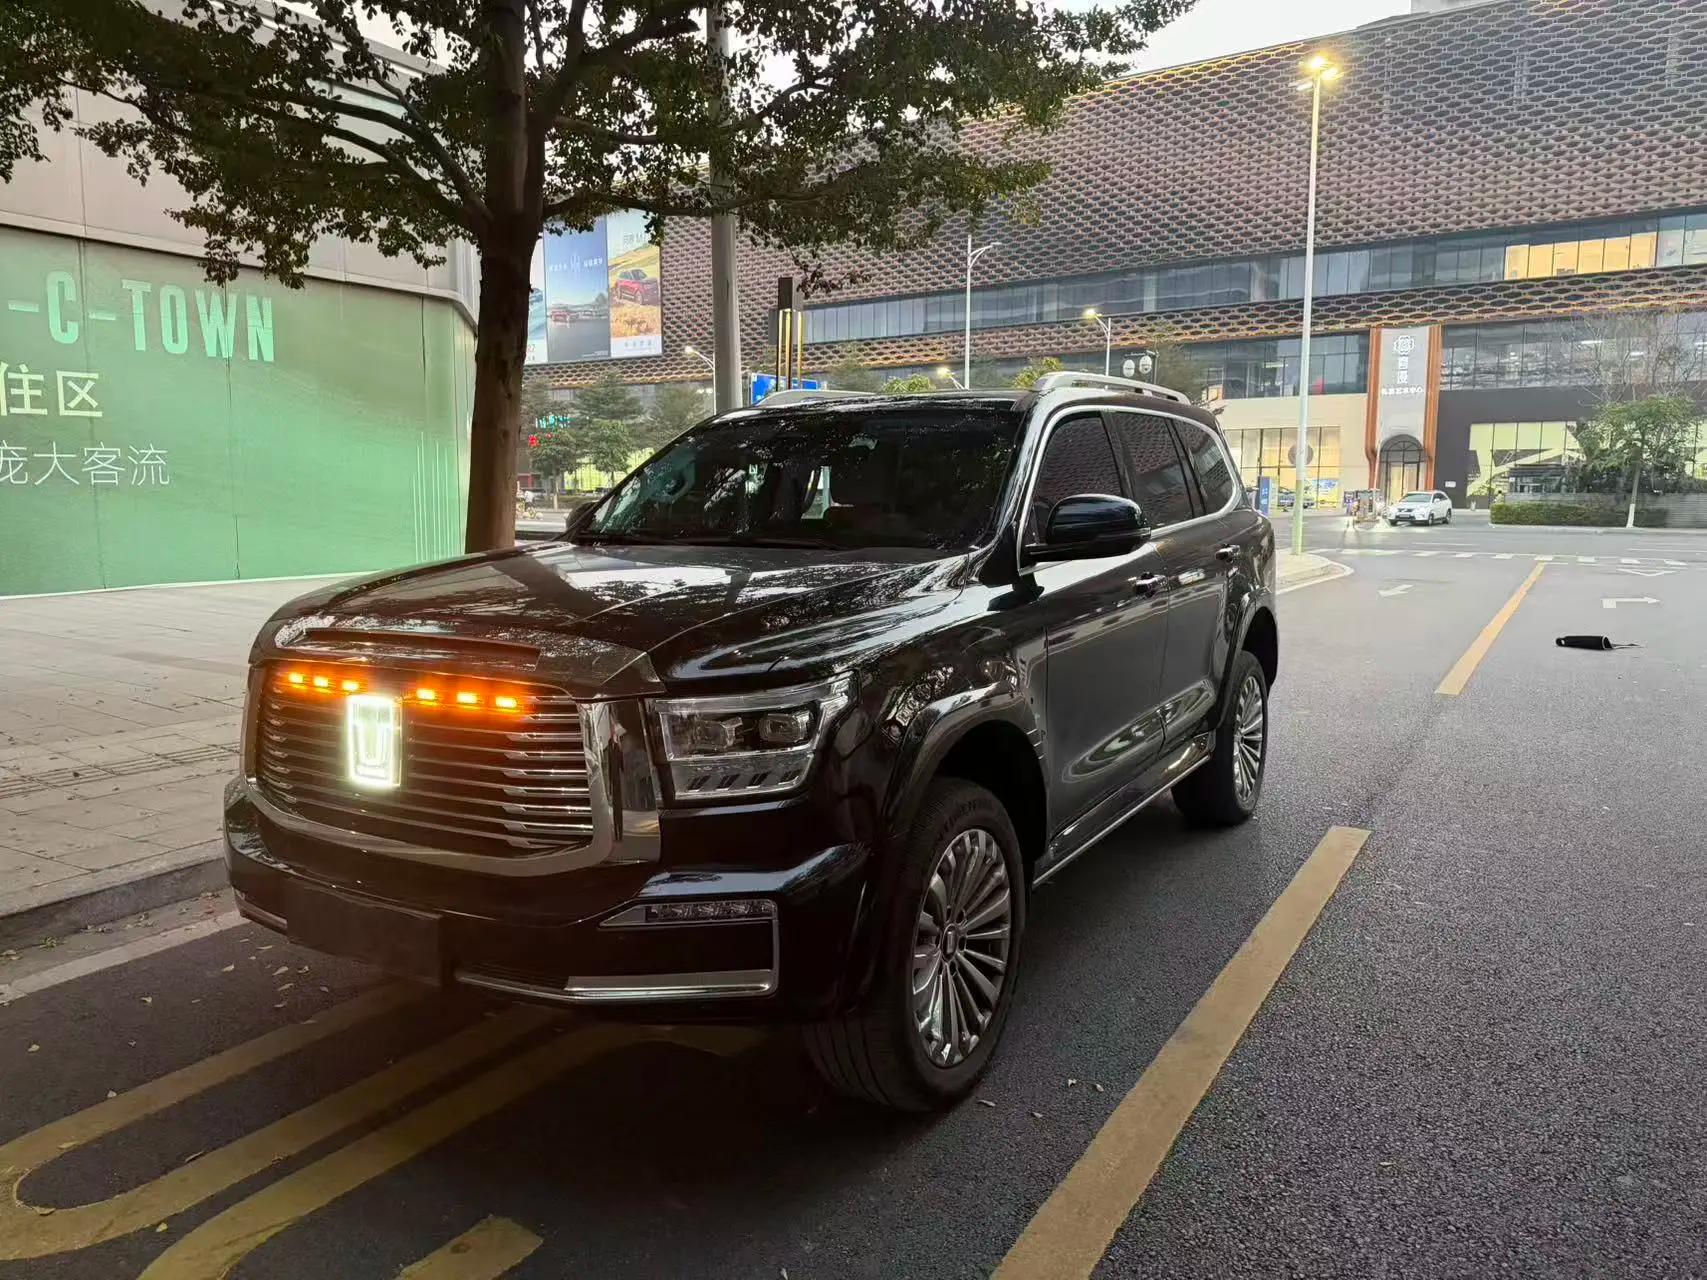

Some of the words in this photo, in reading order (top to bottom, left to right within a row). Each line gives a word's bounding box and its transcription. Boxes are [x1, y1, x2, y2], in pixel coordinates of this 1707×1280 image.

[0, 362, 103, 417] 住区
[0, 440, 170, 486] 庞大客流
